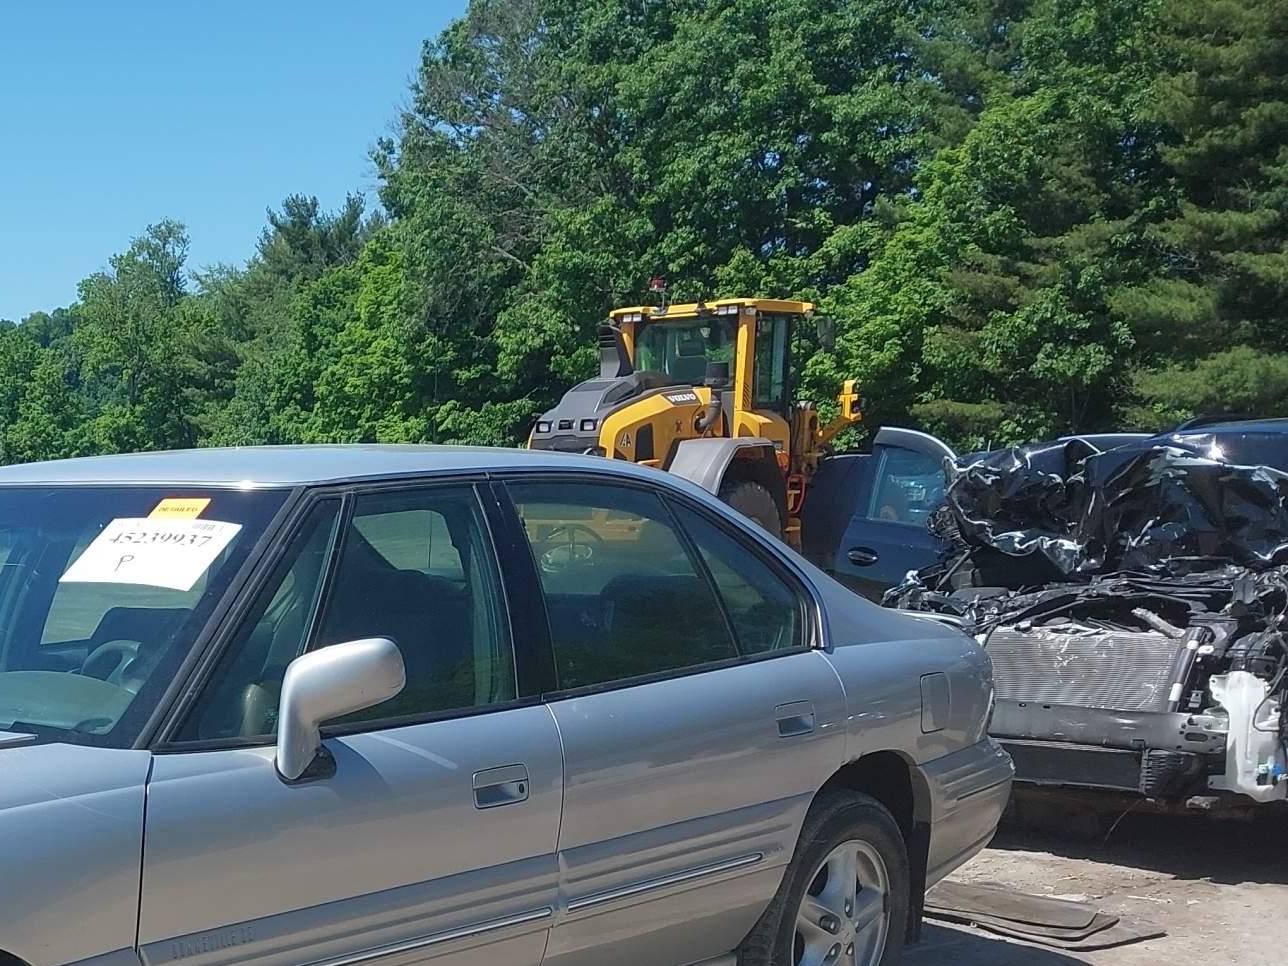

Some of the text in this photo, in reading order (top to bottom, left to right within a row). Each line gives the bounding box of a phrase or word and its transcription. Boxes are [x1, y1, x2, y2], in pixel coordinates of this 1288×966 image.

[667, 394, 696, 402] VOLVO
[109, 532, 214, 547] 45239937
[114, 553, 135, 573] P
